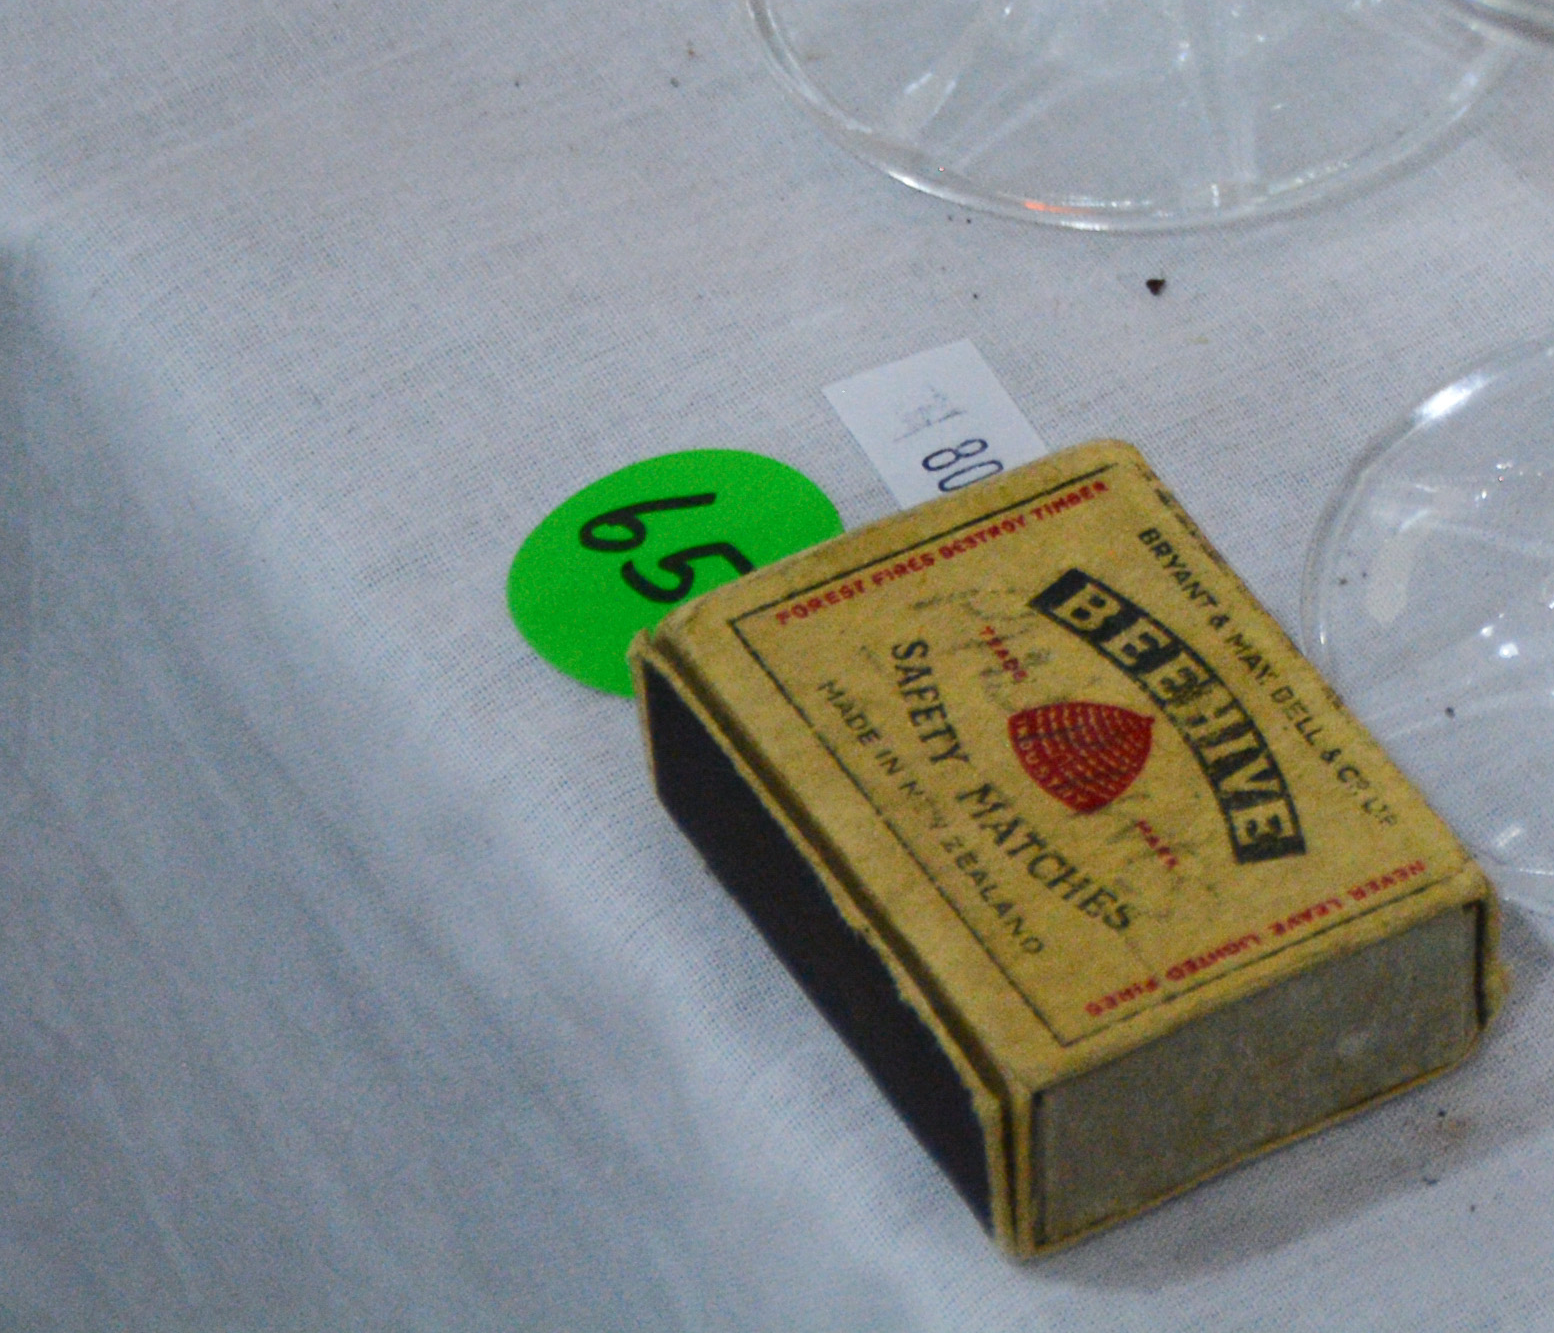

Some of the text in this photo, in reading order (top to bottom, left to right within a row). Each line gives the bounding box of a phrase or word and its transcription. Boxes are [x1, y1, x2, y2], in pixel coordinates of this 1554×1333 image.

[579, 492, 757, 603] 65
[775, 480, 1109, 626] FOREST FIRES DESTROY TIMBER
[1138, 527, 1218, 608] BRYANT
[1208, 613, 1231, 630] &
[816, 678, 882, 747] MADE
[875, 748, 901, 777] IN
[940, 835, 1045, 955] ZEALAND
[891, 639, 1131, 932] SAFETY MATCHES
[1050, 582, 1299, 847] BEEHIVE
